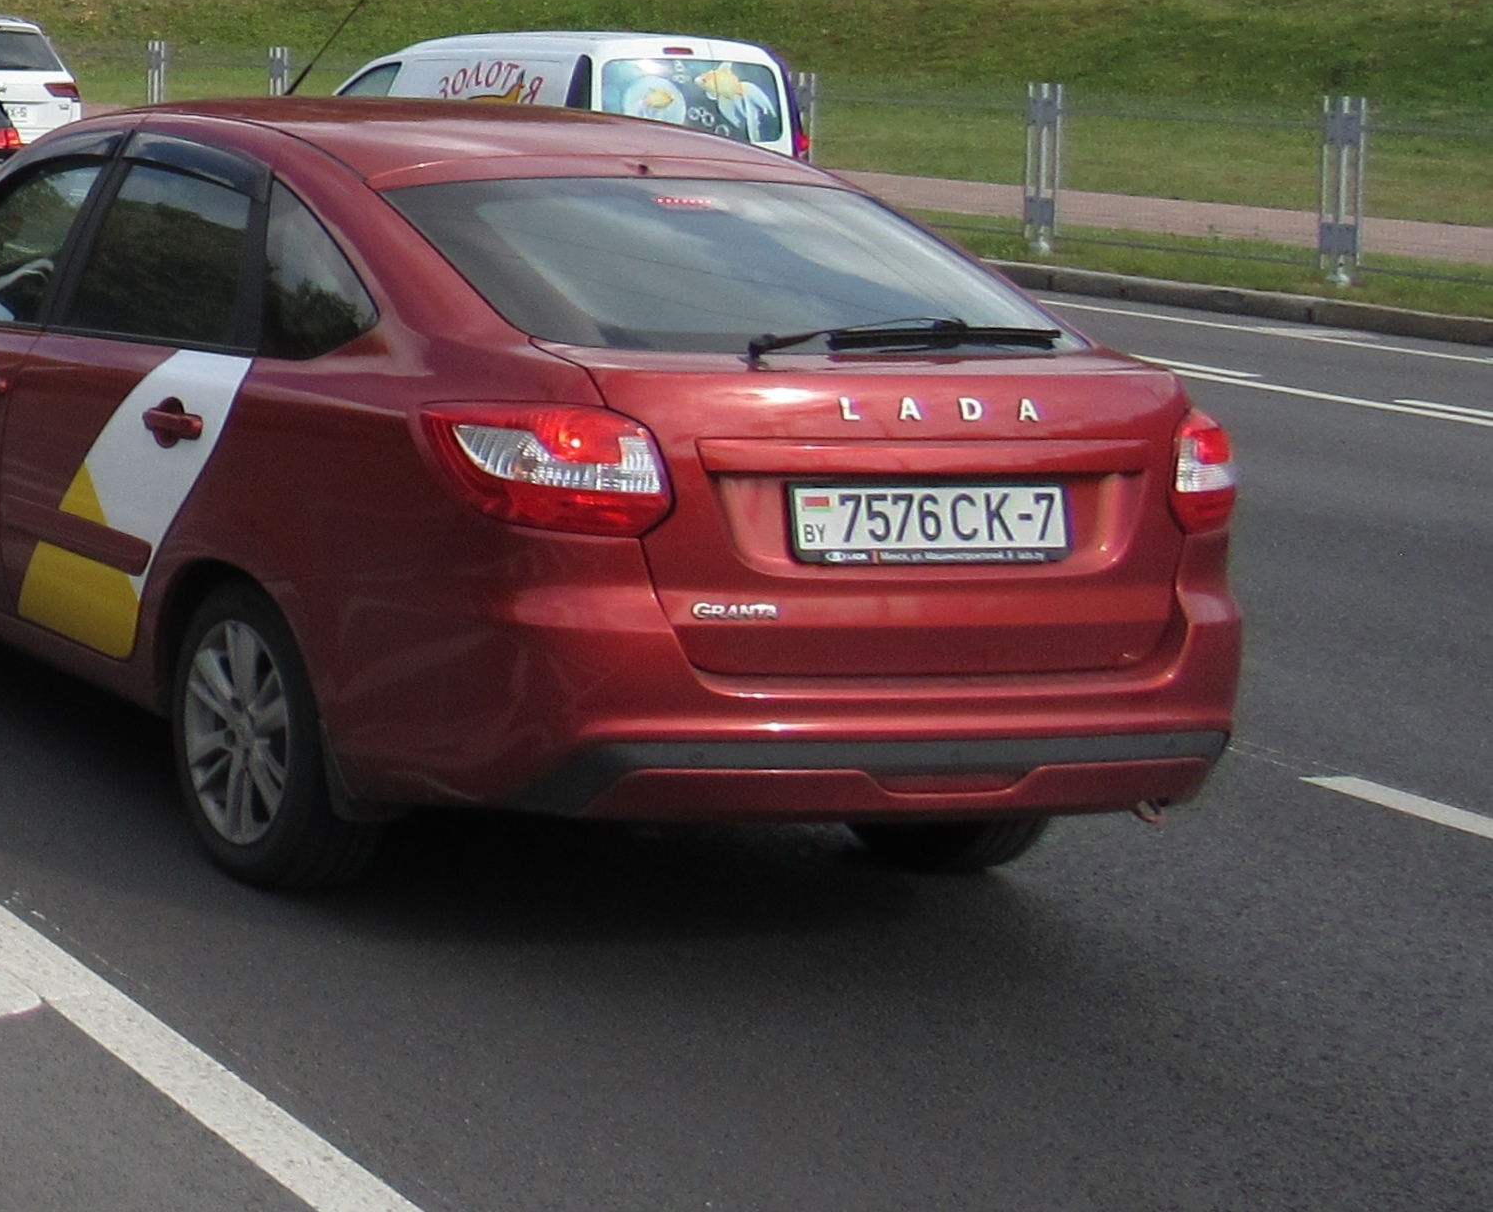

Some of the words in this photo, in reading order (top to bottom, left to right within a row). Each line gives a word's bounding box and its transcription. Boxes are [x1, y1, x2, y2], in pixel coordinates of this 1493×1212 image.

[438, 60, 544, 104] ЗОЛОТАЯ
[838, 396, 1040, 421] LADA
[803, 523, 826, 543] BY
[692, 602, 777, 619] GRANTA
